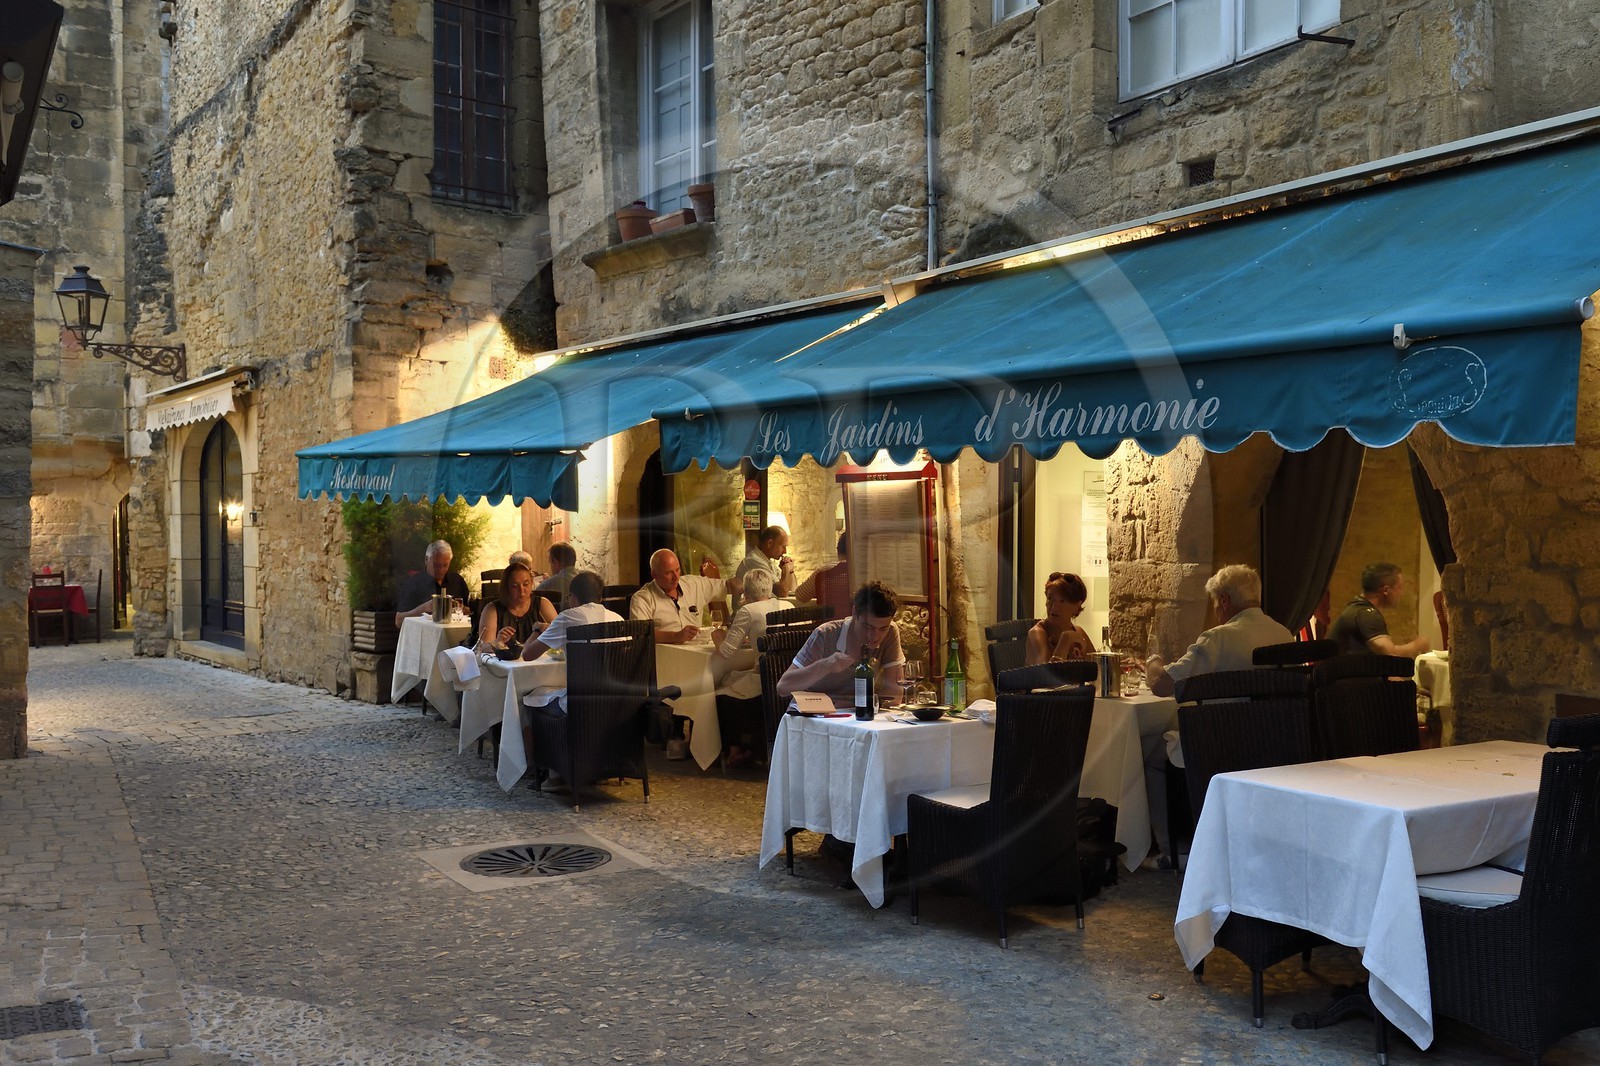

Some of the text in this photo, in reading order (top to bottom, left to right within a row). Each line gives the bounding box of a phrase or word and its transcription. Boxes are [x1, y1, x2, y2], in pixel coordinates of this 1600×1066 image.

[756, 378, 1220, 467] Les Jardins d'Harmonie
[330, 461, 395, 491] Restaurant
